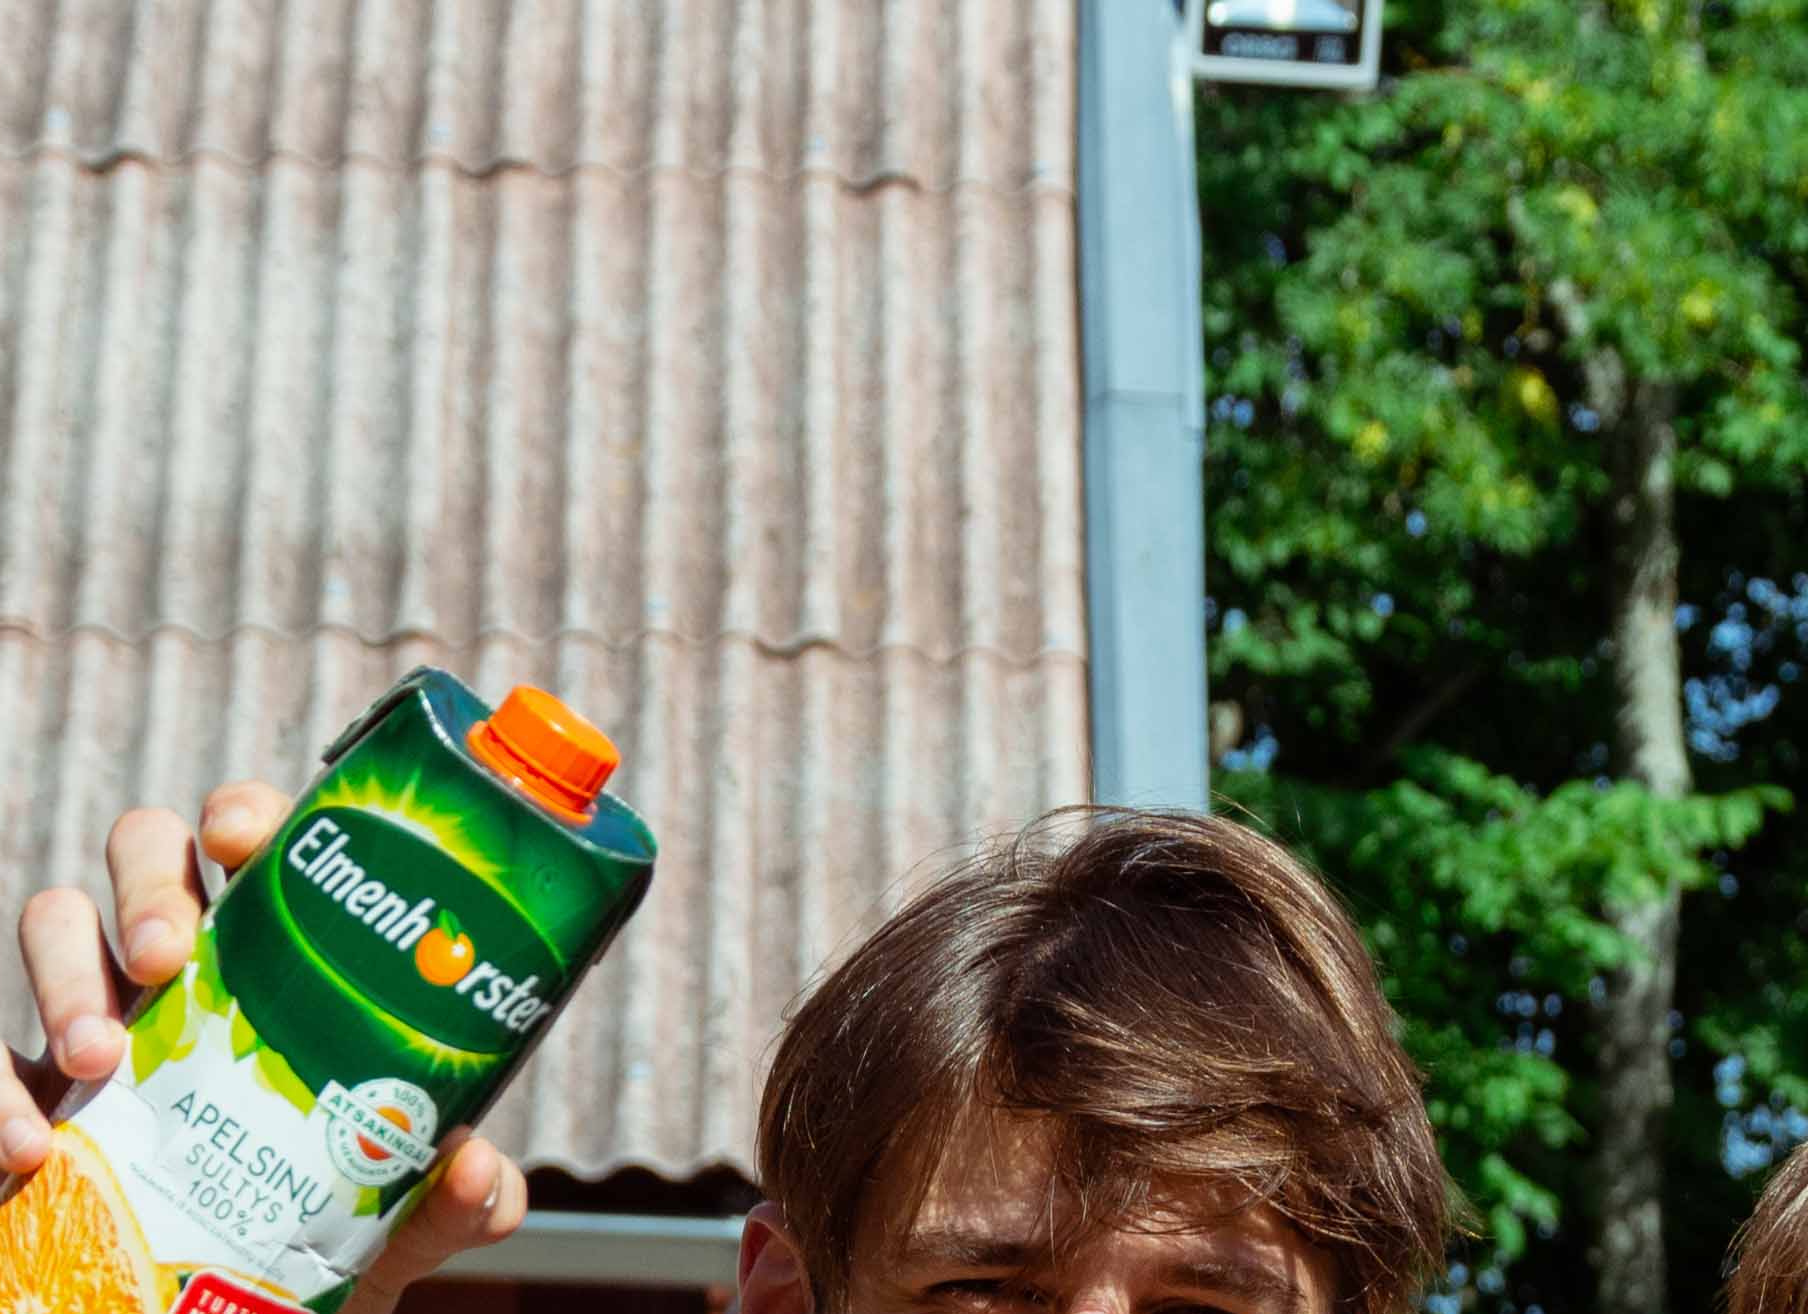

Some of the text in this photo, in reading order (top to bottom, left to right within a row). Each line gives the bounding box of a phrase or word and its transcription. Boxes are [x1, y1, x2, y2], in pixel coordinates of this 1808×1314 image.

[170, 1090, 334, 1224] APELSINŲ
[185, 1143, 284, 1223] SULTYS
[189, 1179, 253, 1236] 100%
